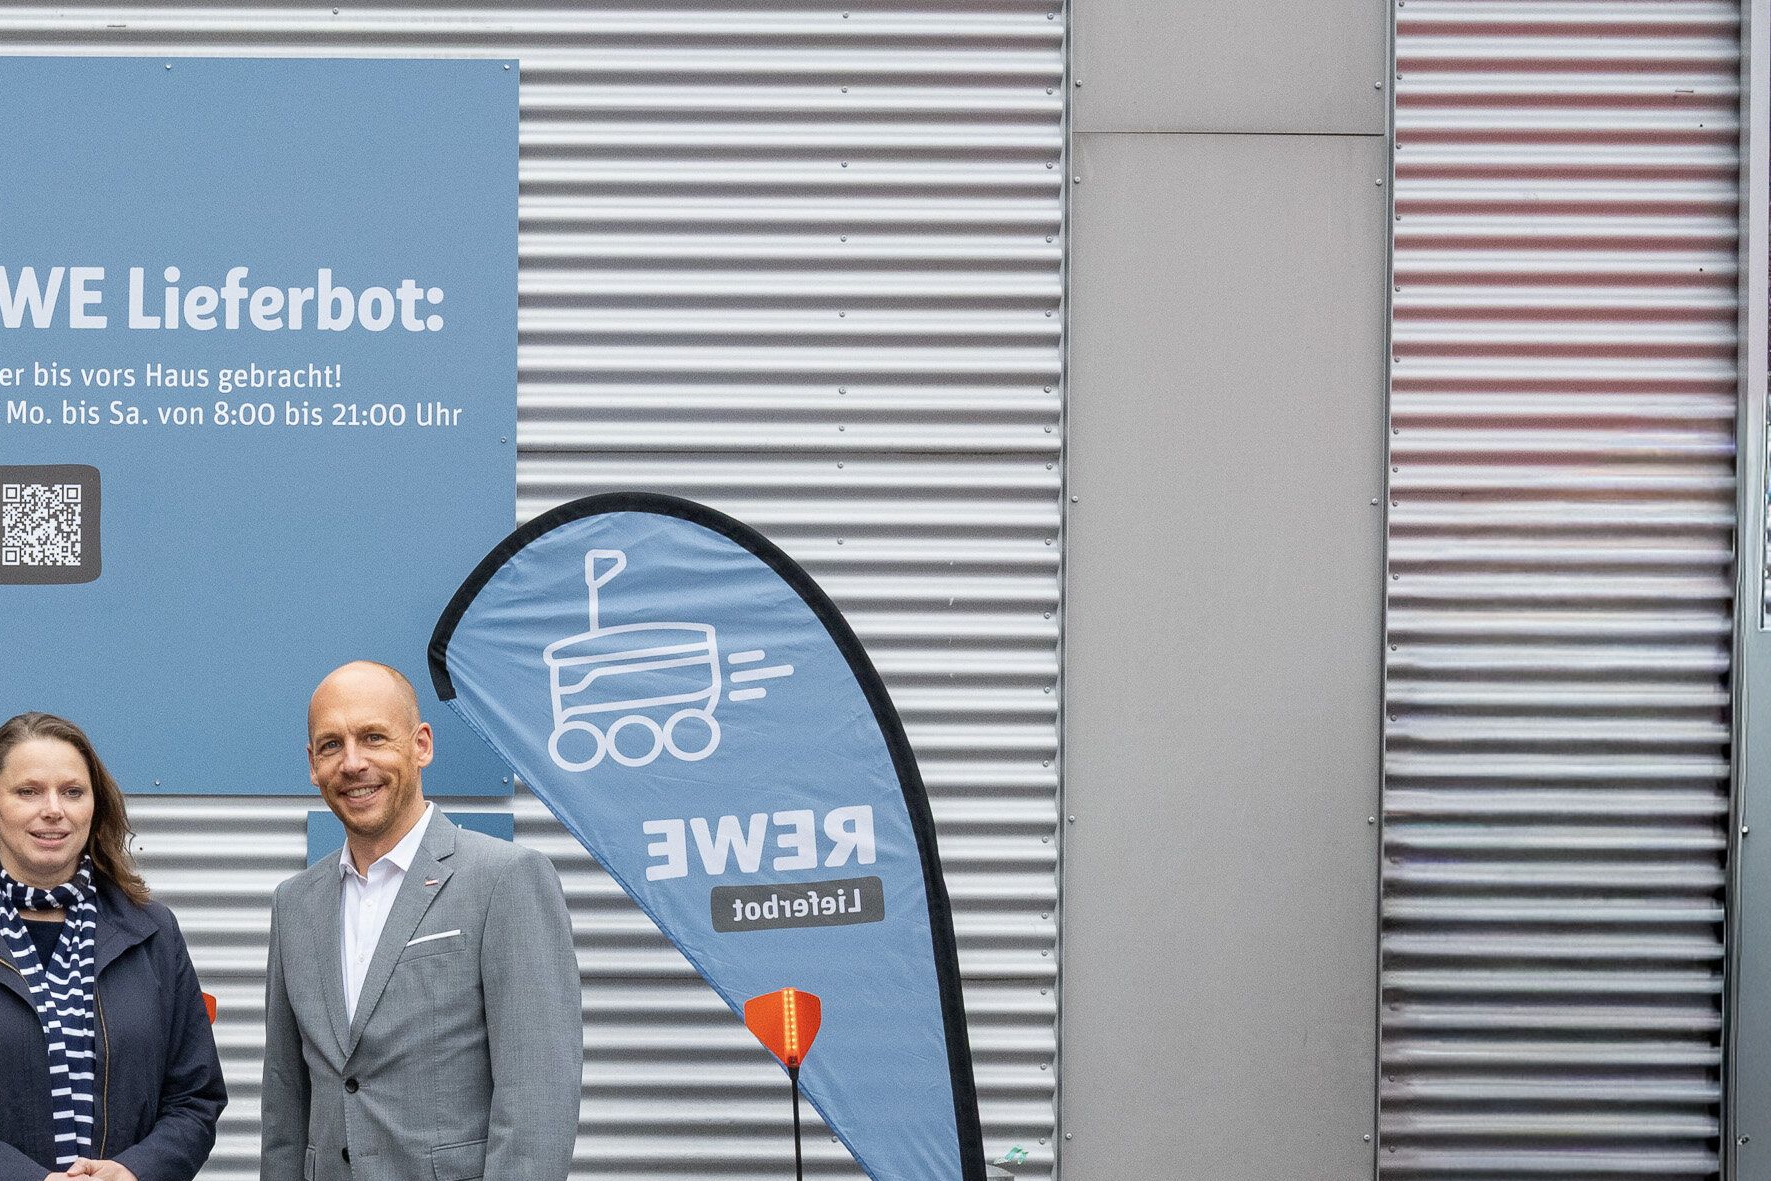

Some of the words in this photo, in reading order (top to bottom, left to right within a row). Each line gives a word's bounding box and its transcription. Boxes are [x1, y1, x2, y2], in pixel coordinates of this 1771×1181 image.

[128, 265, 445, 332] Lieferbot:
[34, 361, 72, 387] bis
[80, 368, 136, 387] vors
[146, 363, 209, 388] Haus
[218, 362, 341, 394] gebracht!
[7, 400, 52, 425] Mo.
[62, 399, 100, 425] bis
[109, 400, 149, 425] Sa.
[157, 406, 204, 425] von
[213, 400, 276, 426] 8:00
[285, 400, 323, 426] bis
[331, 403, 406, 426] 21:00
[416, 401, 463, 427] Uhr
